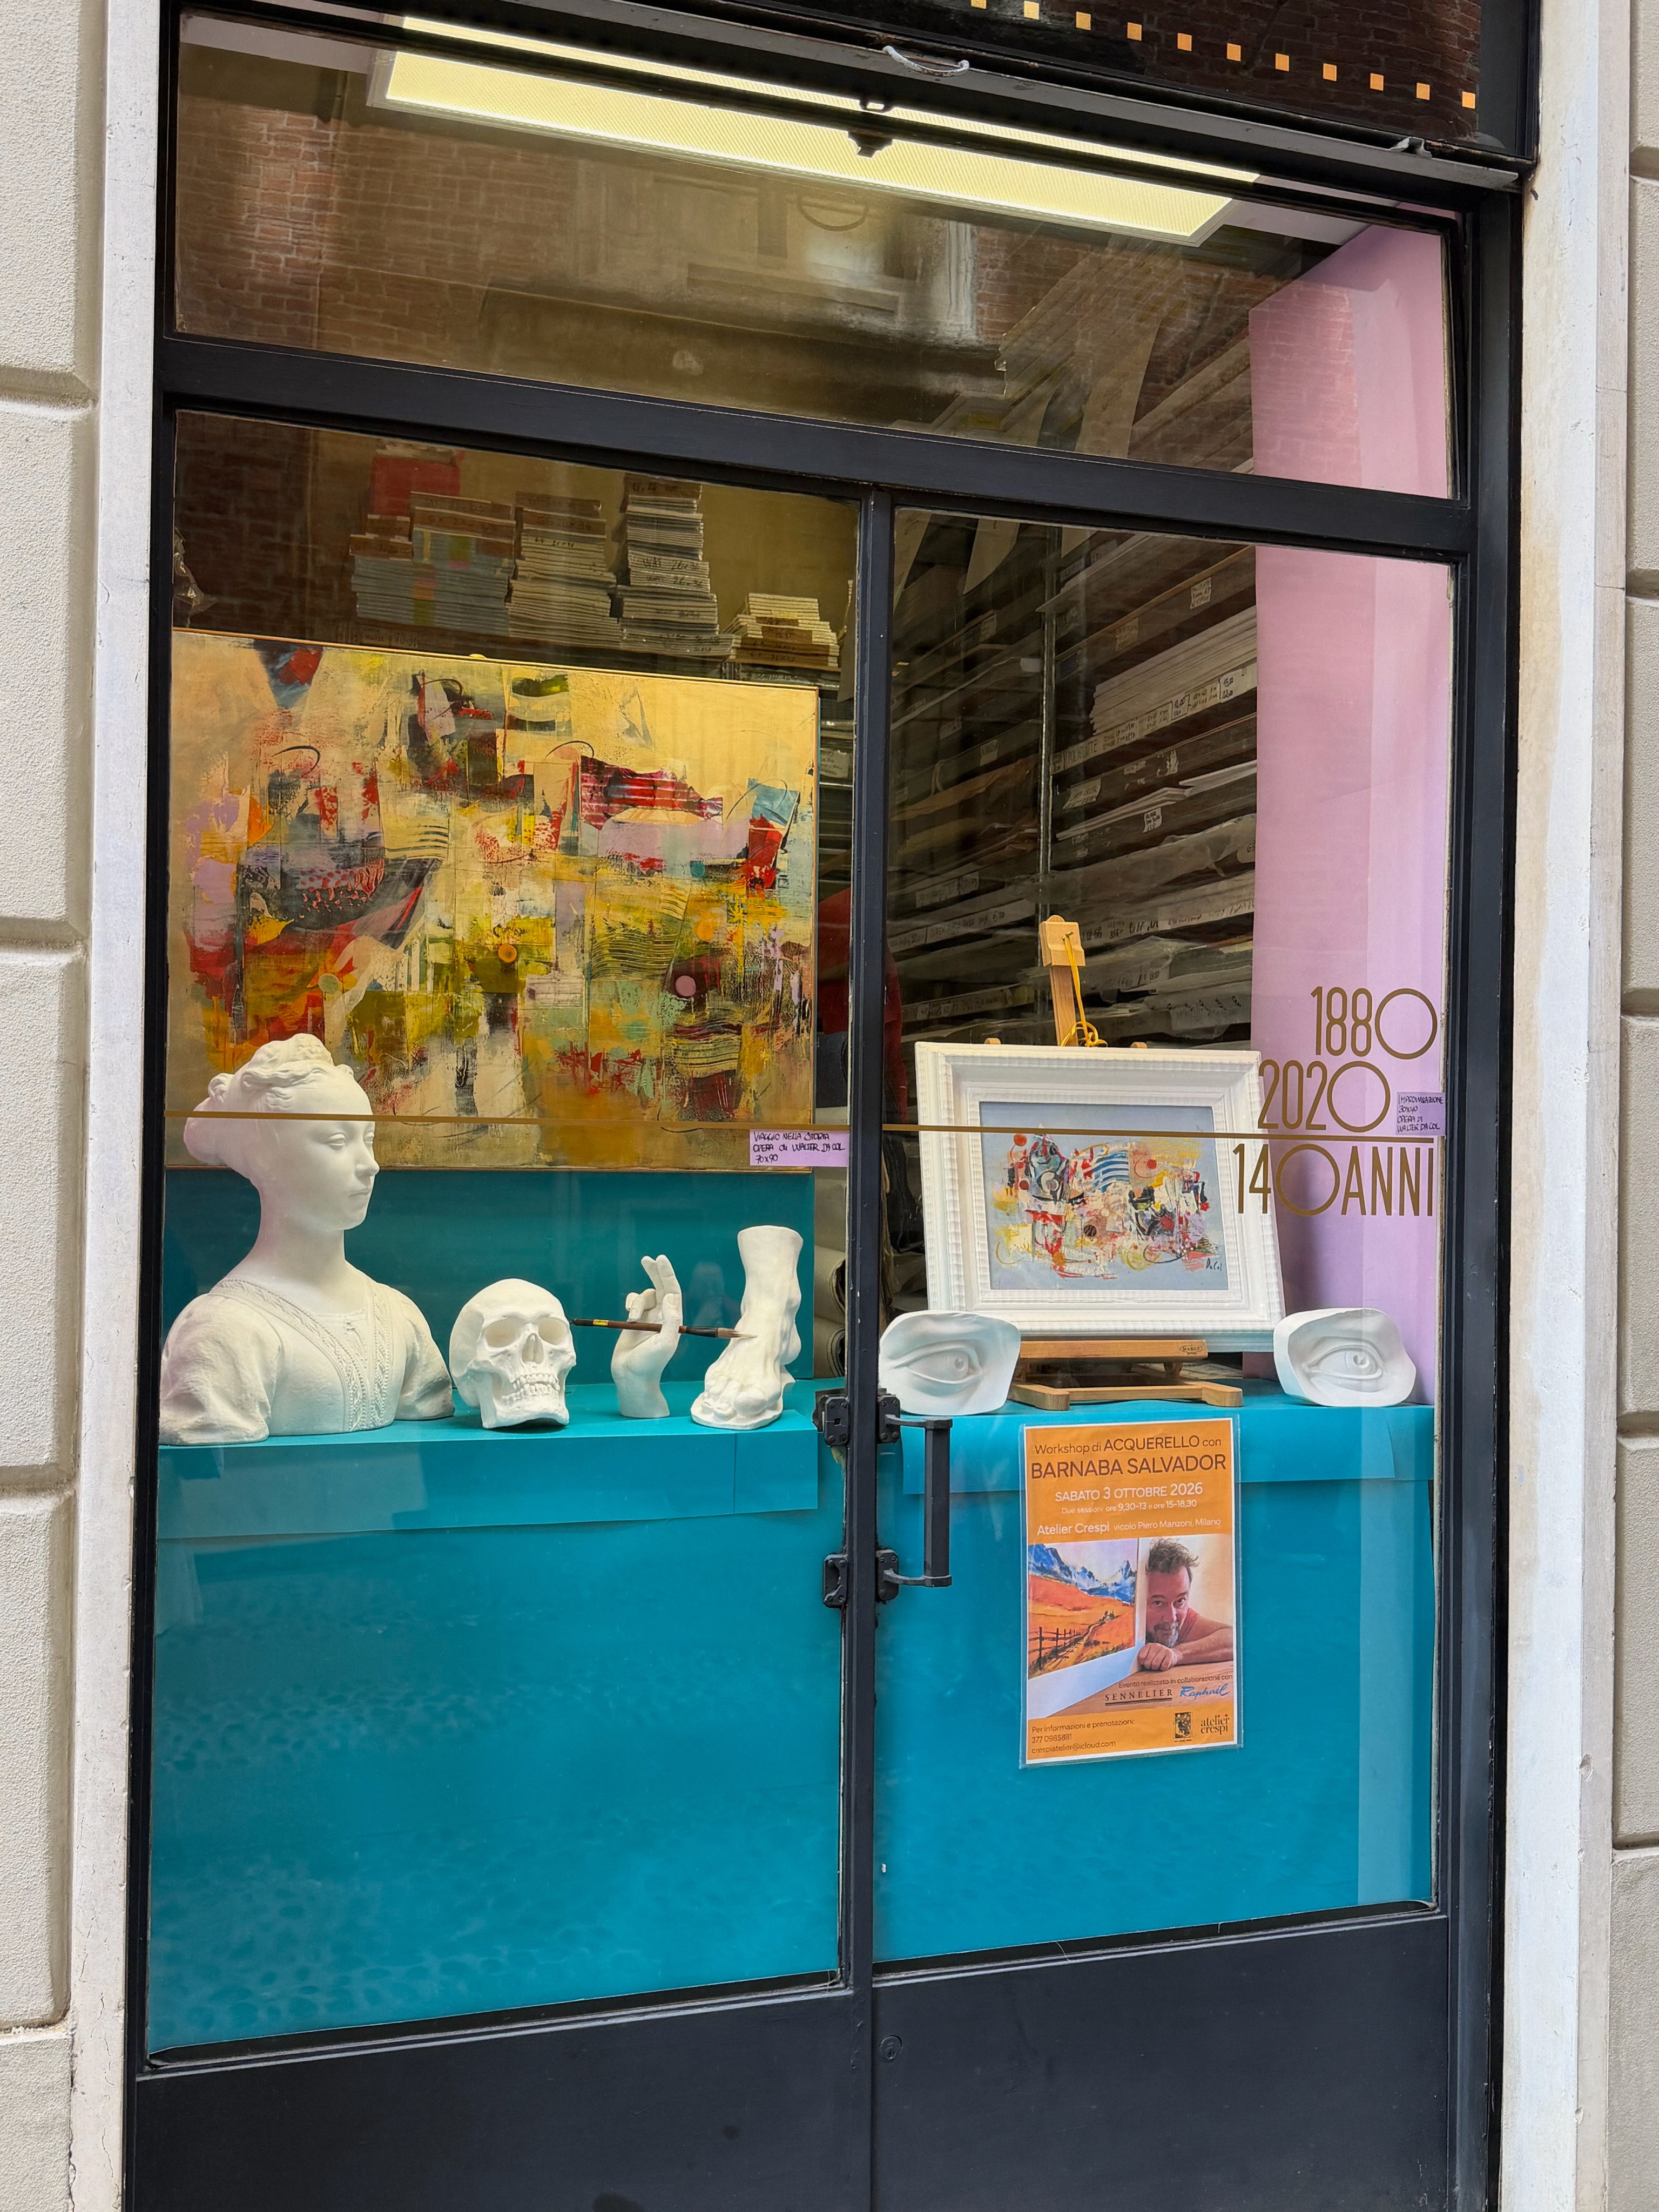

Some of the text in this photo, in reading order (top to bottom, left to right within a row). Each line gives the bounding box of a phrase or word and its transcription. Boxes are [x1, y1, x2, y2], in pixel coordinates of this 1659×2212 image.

[1311, 986, 1438, 1060] 1880
[1258, 1060, 1391, 1133] 2020
[1397, 1115, 1415, 1123] OPERA
[1397, 1124, 1419, 1132] WALTER
[754, 1132, 780, 1142] VIAGGIO
[753, 1144, 773, 1152] OPERA
[792, 1143, 819, 1151] WALTER
[821, 1143, 831, 1152] DA
[832, 1143, 846, 1151] COL
[1035, 1435, 1222, 1455] Workshop di ACQUERELLO con
[1031, 1454, 1226, 1479] BARNABA SALVADOR
[1055, 1482, 1203, 1502] SABATO 3 OTTOBRE 2026
[1118, 1502, 1147, 1512] 9,30-13
[1166, 1499, 1197, 1509] 15-18,30
[1037, 1523, 1073, 1536] Atelier
[1075, 1521, 1110, 1534] Crespi
[1114, 1522, 1136, 1530] vicolo
[1138, 1521, 1158, 1529] Piero
[1195, 1518, 1222, 1526] Milano
[1177, 1675, 1220, 1684] collaborazione
[1105, 1689, 1172, 1701] SENNELIER
[1044, 1722, 1085, 1732] informazioni
[1201, 1714, 1230, 1727] atelier
[1201, 1725, 1228, 1735] crespi
[1031, 1741, 1116, 1754] crespiatelier@icloud.com
